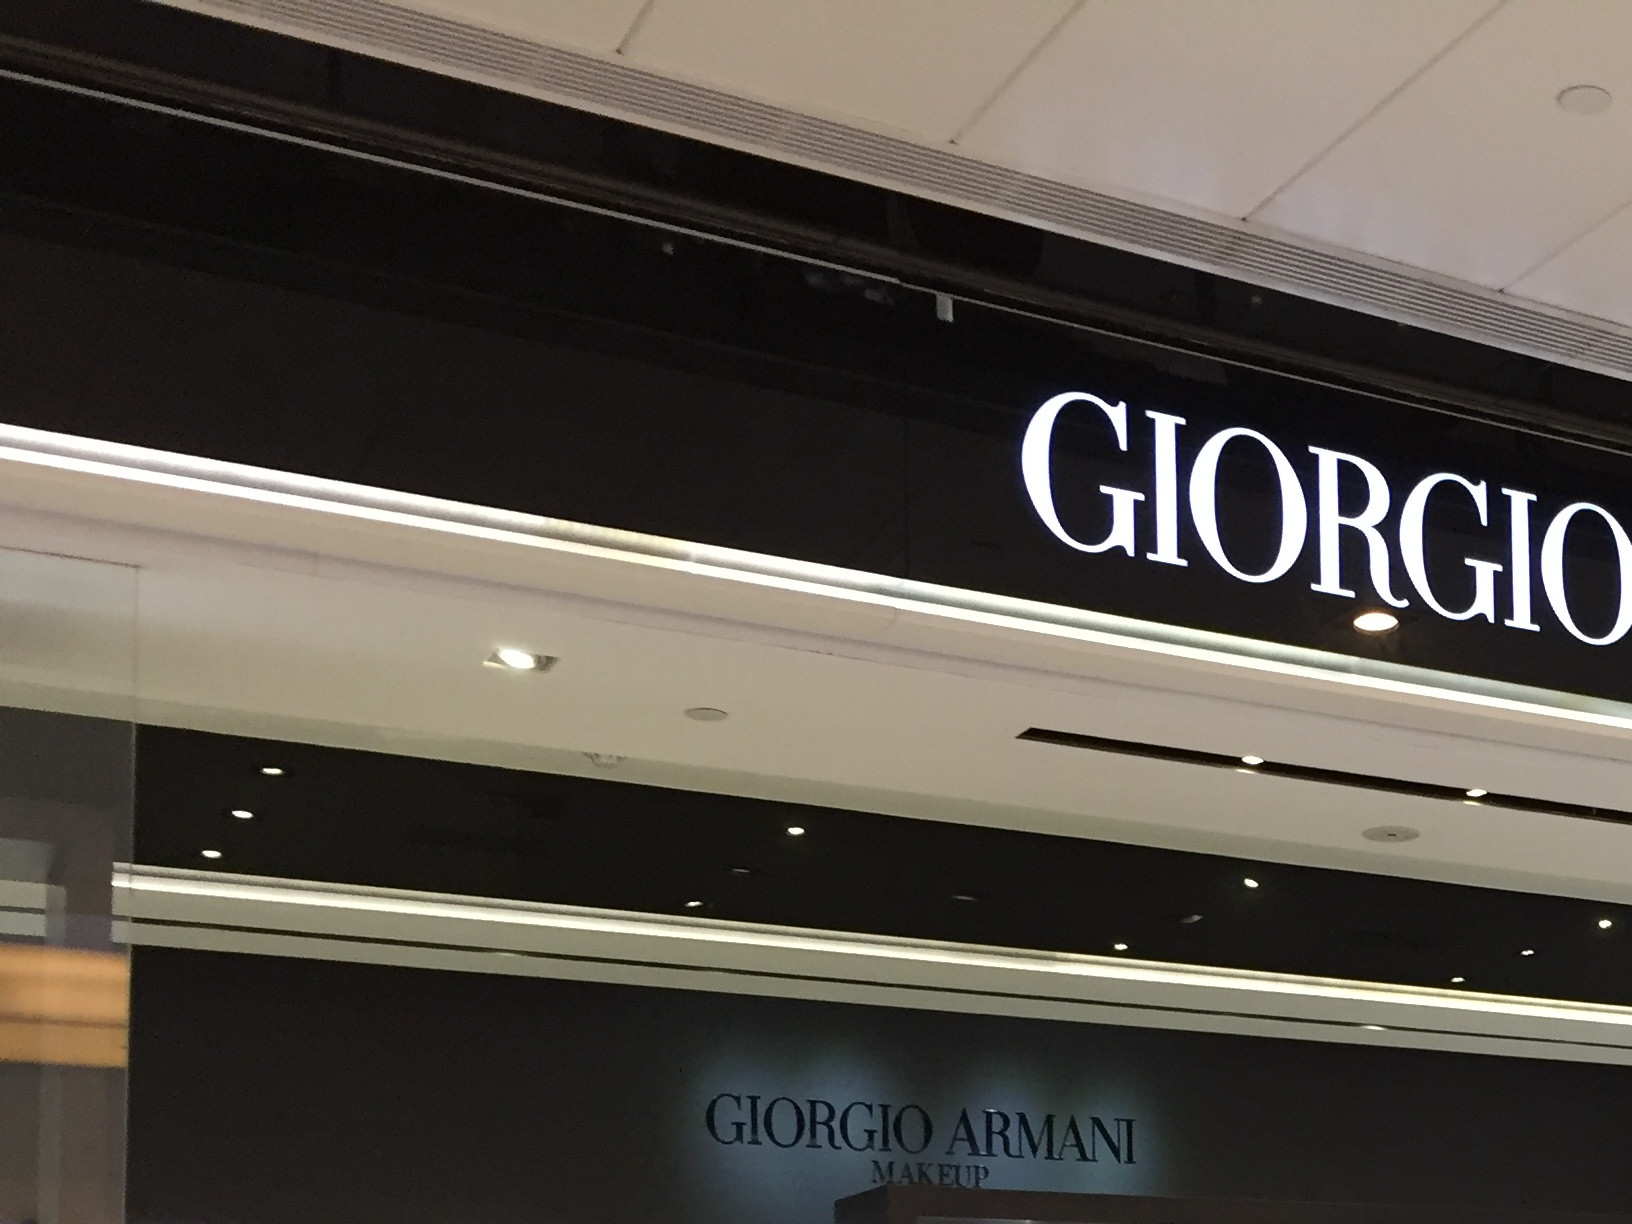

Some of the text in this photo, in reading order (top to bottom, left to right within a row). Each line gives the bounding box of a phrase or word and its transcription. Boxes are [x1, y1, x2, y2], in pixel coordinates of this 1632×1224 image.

[705, 1093, 1138, 1165] GIORGIO ARMANI
[871, 1160, 990, 1188] MAKEUP
